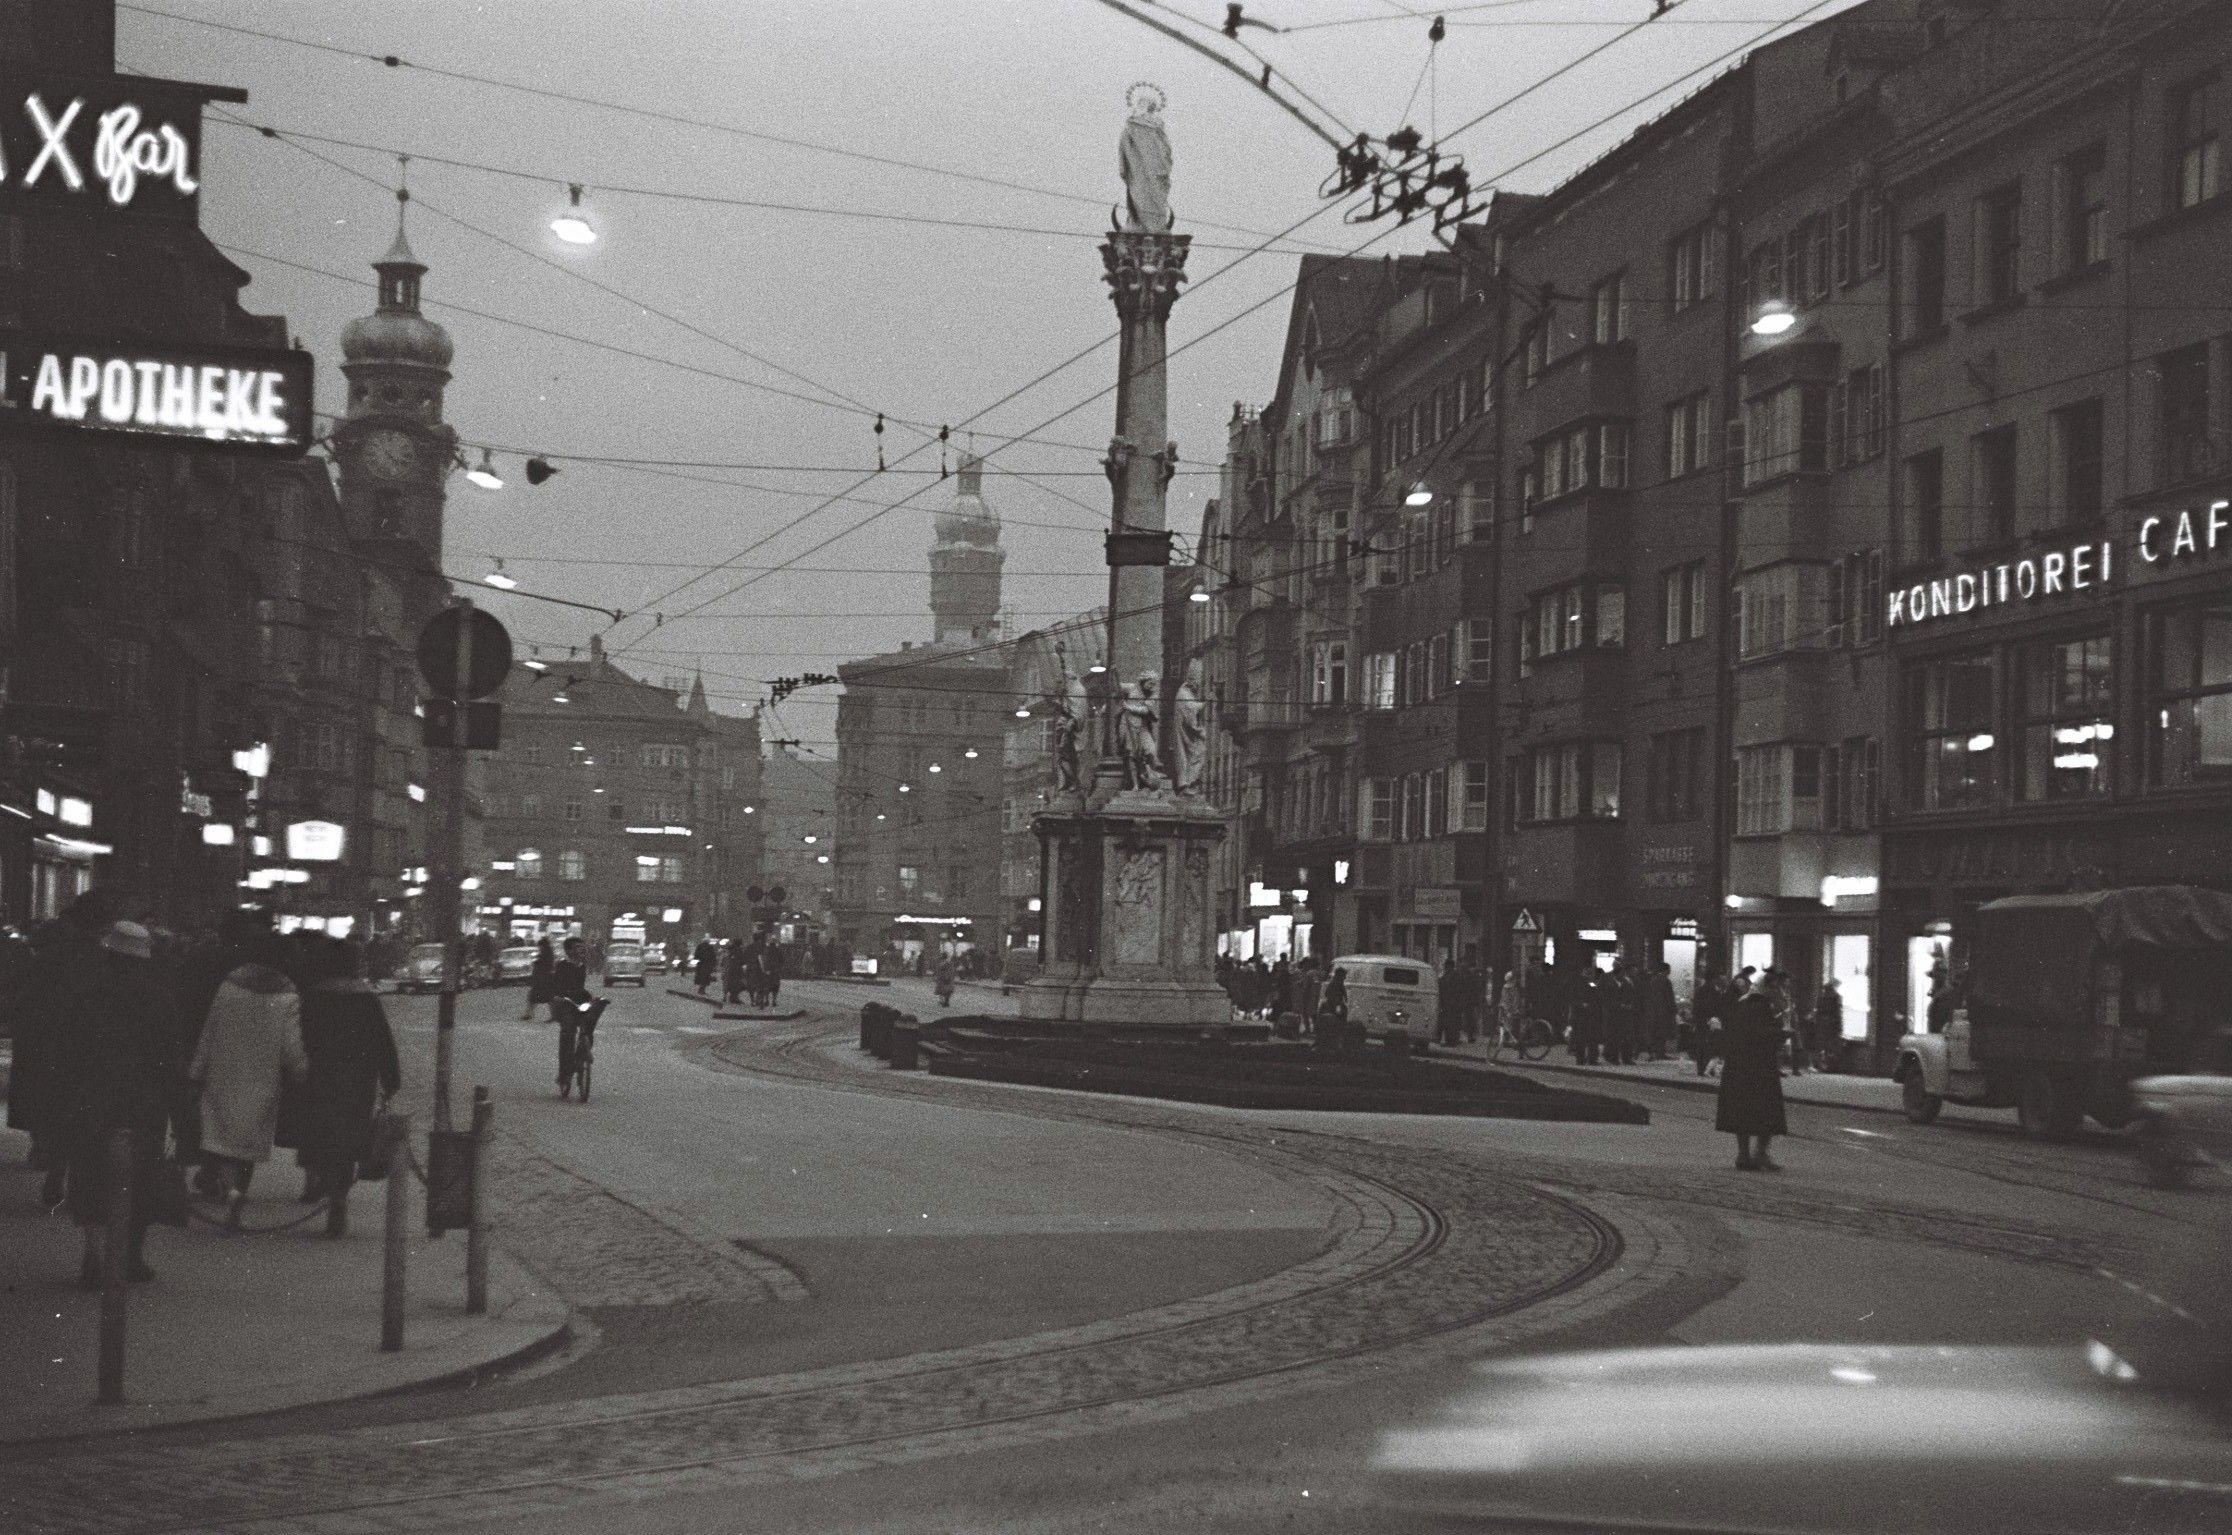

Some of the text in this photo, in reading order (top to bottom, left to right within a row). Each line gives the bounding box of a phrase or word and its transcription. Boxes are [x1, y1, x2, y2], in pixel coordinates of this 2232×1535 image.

[95, 104, 199, 204] Bar
[1888, 500, 2231, 627] KONDITOREI CAF
